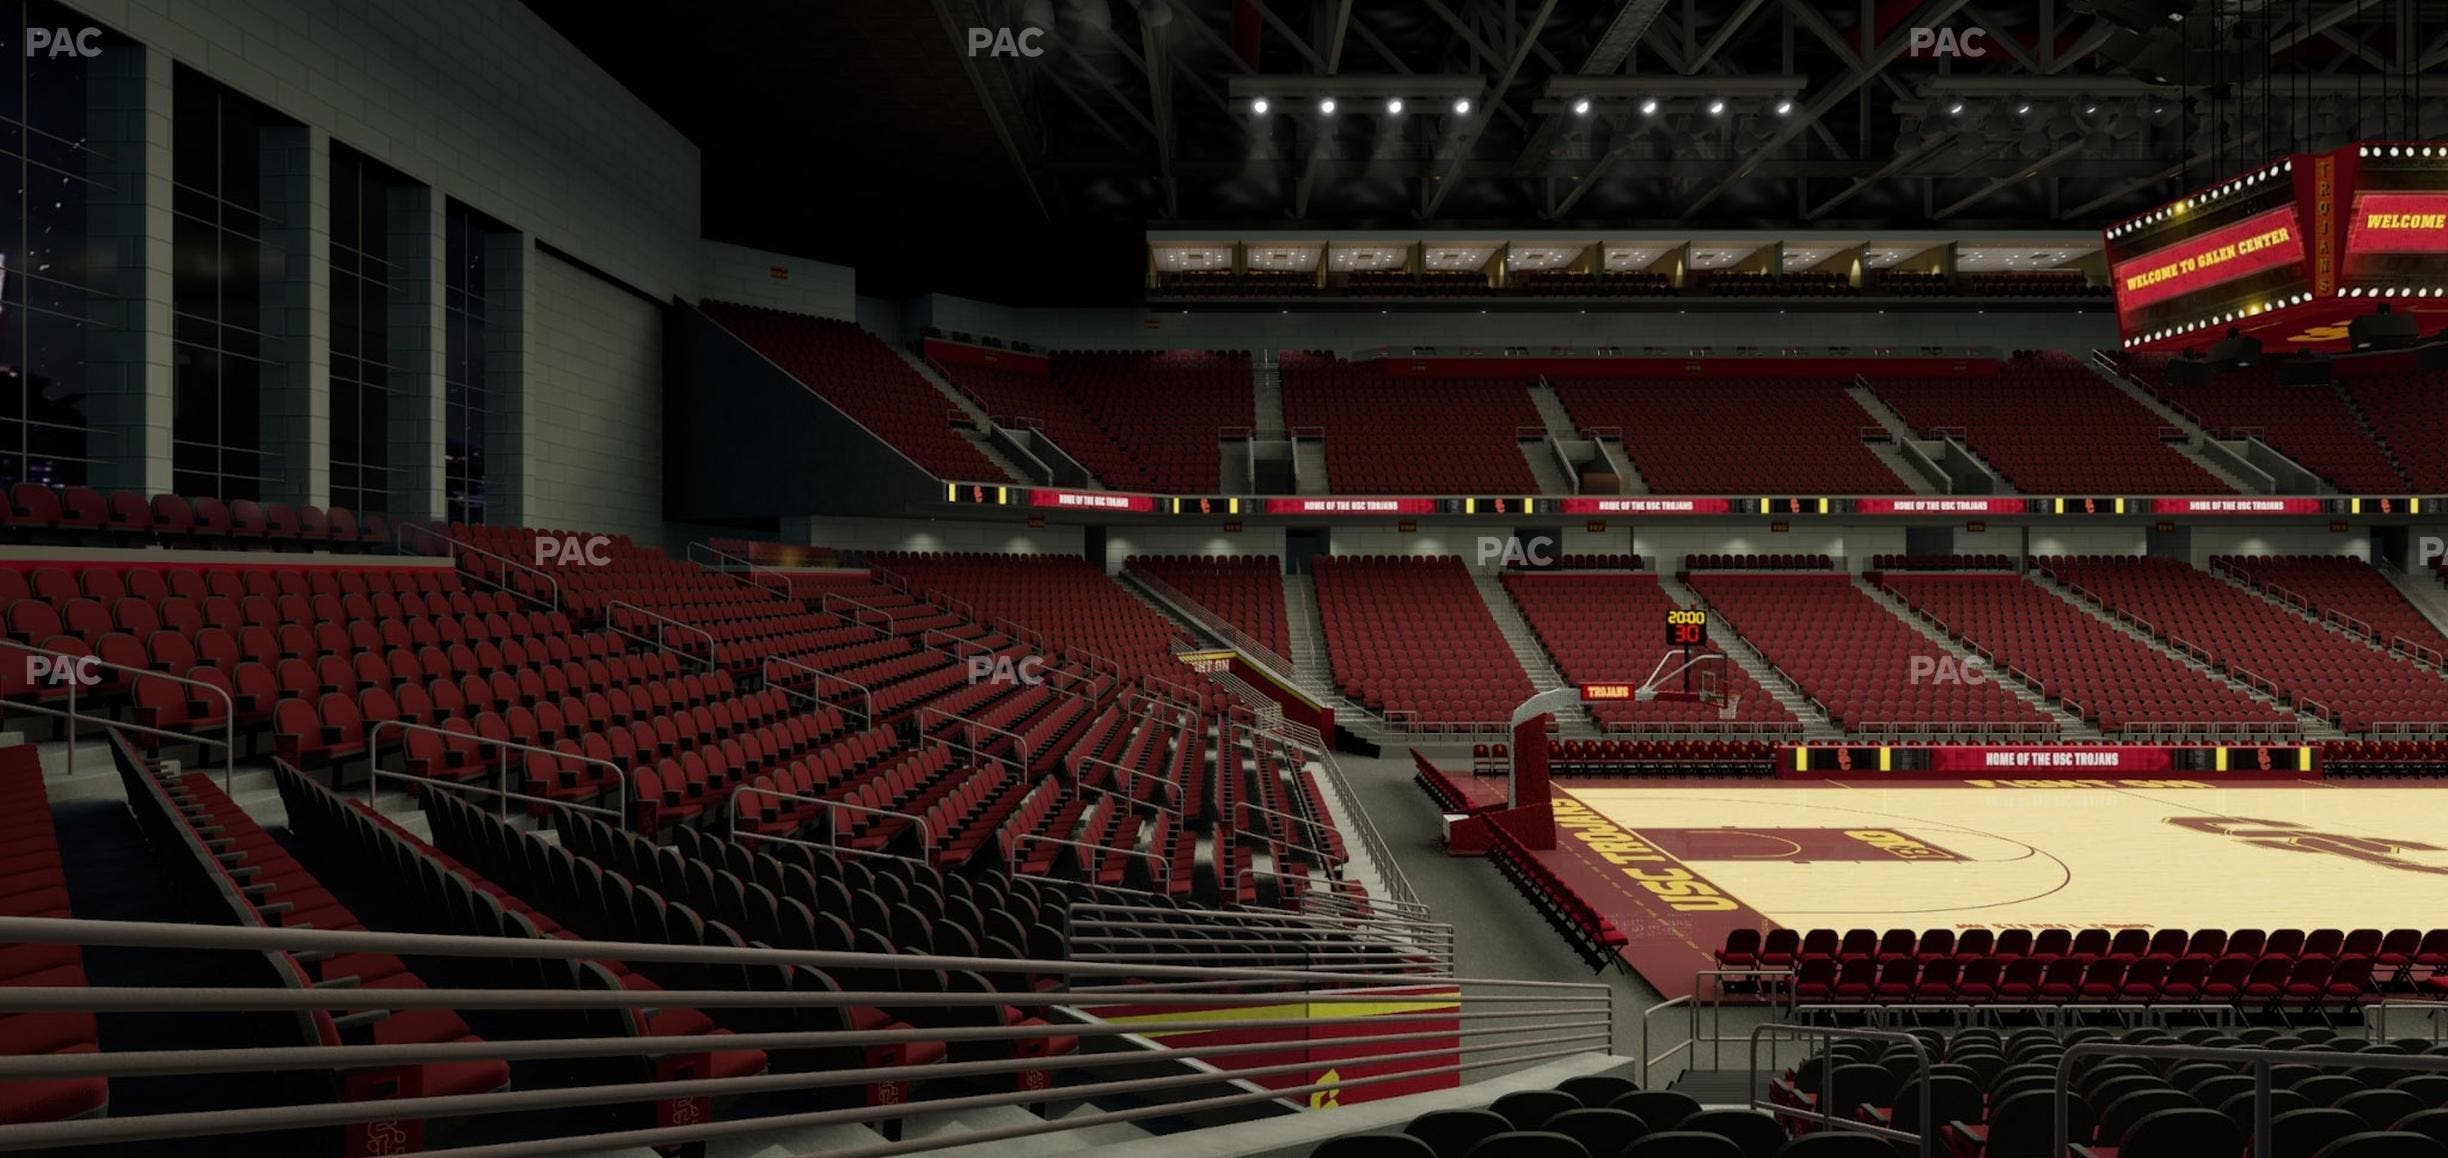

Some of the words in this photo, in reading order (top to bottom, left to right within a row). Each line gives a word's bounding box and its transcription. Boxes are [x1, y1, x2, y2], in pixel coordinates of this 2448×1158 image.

[2319, 162, 2330, 294] TROJANS
[2366, 213, 2447, 230] WELCOME
[2127, 264, 2178, 291] WELCOME
[2180, 258, 2196, 274] TO
[2197, 246, 2236, 269] GALEN
[2238, 227, 2290, 255] CENTER
[1304, 500, 1324, 511] HOME
[1326, 500, 1335, 511] OF
[1337, 500, 1350, 511] THE
[1352, 500, 1365, 511] USC
[1367, 500, 1398, 511] TROJANS
[1599, 500, 1619, 511] HOME
[1621, 500, 1630, 511] OF
[1631, 500, 1644, 511] THE
[1646, 500, 1660, 511] USC
[1662, 500, 1692, 511] TROJANS
[1894, 500, 1914, 511] HOME
[1916, 500, 1925, 511] OF
[1926, 500, 1939, 511] THE
[1941, 500, 1955, 511] USC
[1957, 500, 1988, 511] TROJANS
[2190, 500, 2210, 511] HOME
[2212, 500, 2221, 511] OF
[2223, 500, 2236, 511] THE
[2238, 500, 2251, 511] USC
[2253, 500, 2284, 511] TROJANS
[1667, 610, 1706, 625] 20:00
[1674, 625, 1700, 643] 30
[1215, 659, 1230, 673] ON
[1587, 685, 1630, 700] TROJANS
[1986, 752, 2015, 766] HOME
[2017, 752, 2030, 766] OF
[2032, 752, 2051, 766] THE
[2052, 752, 2072, 766] USC
[2074, 752, 2119, 766] TROJANS
[1621, 868, 1739, 912] USC
